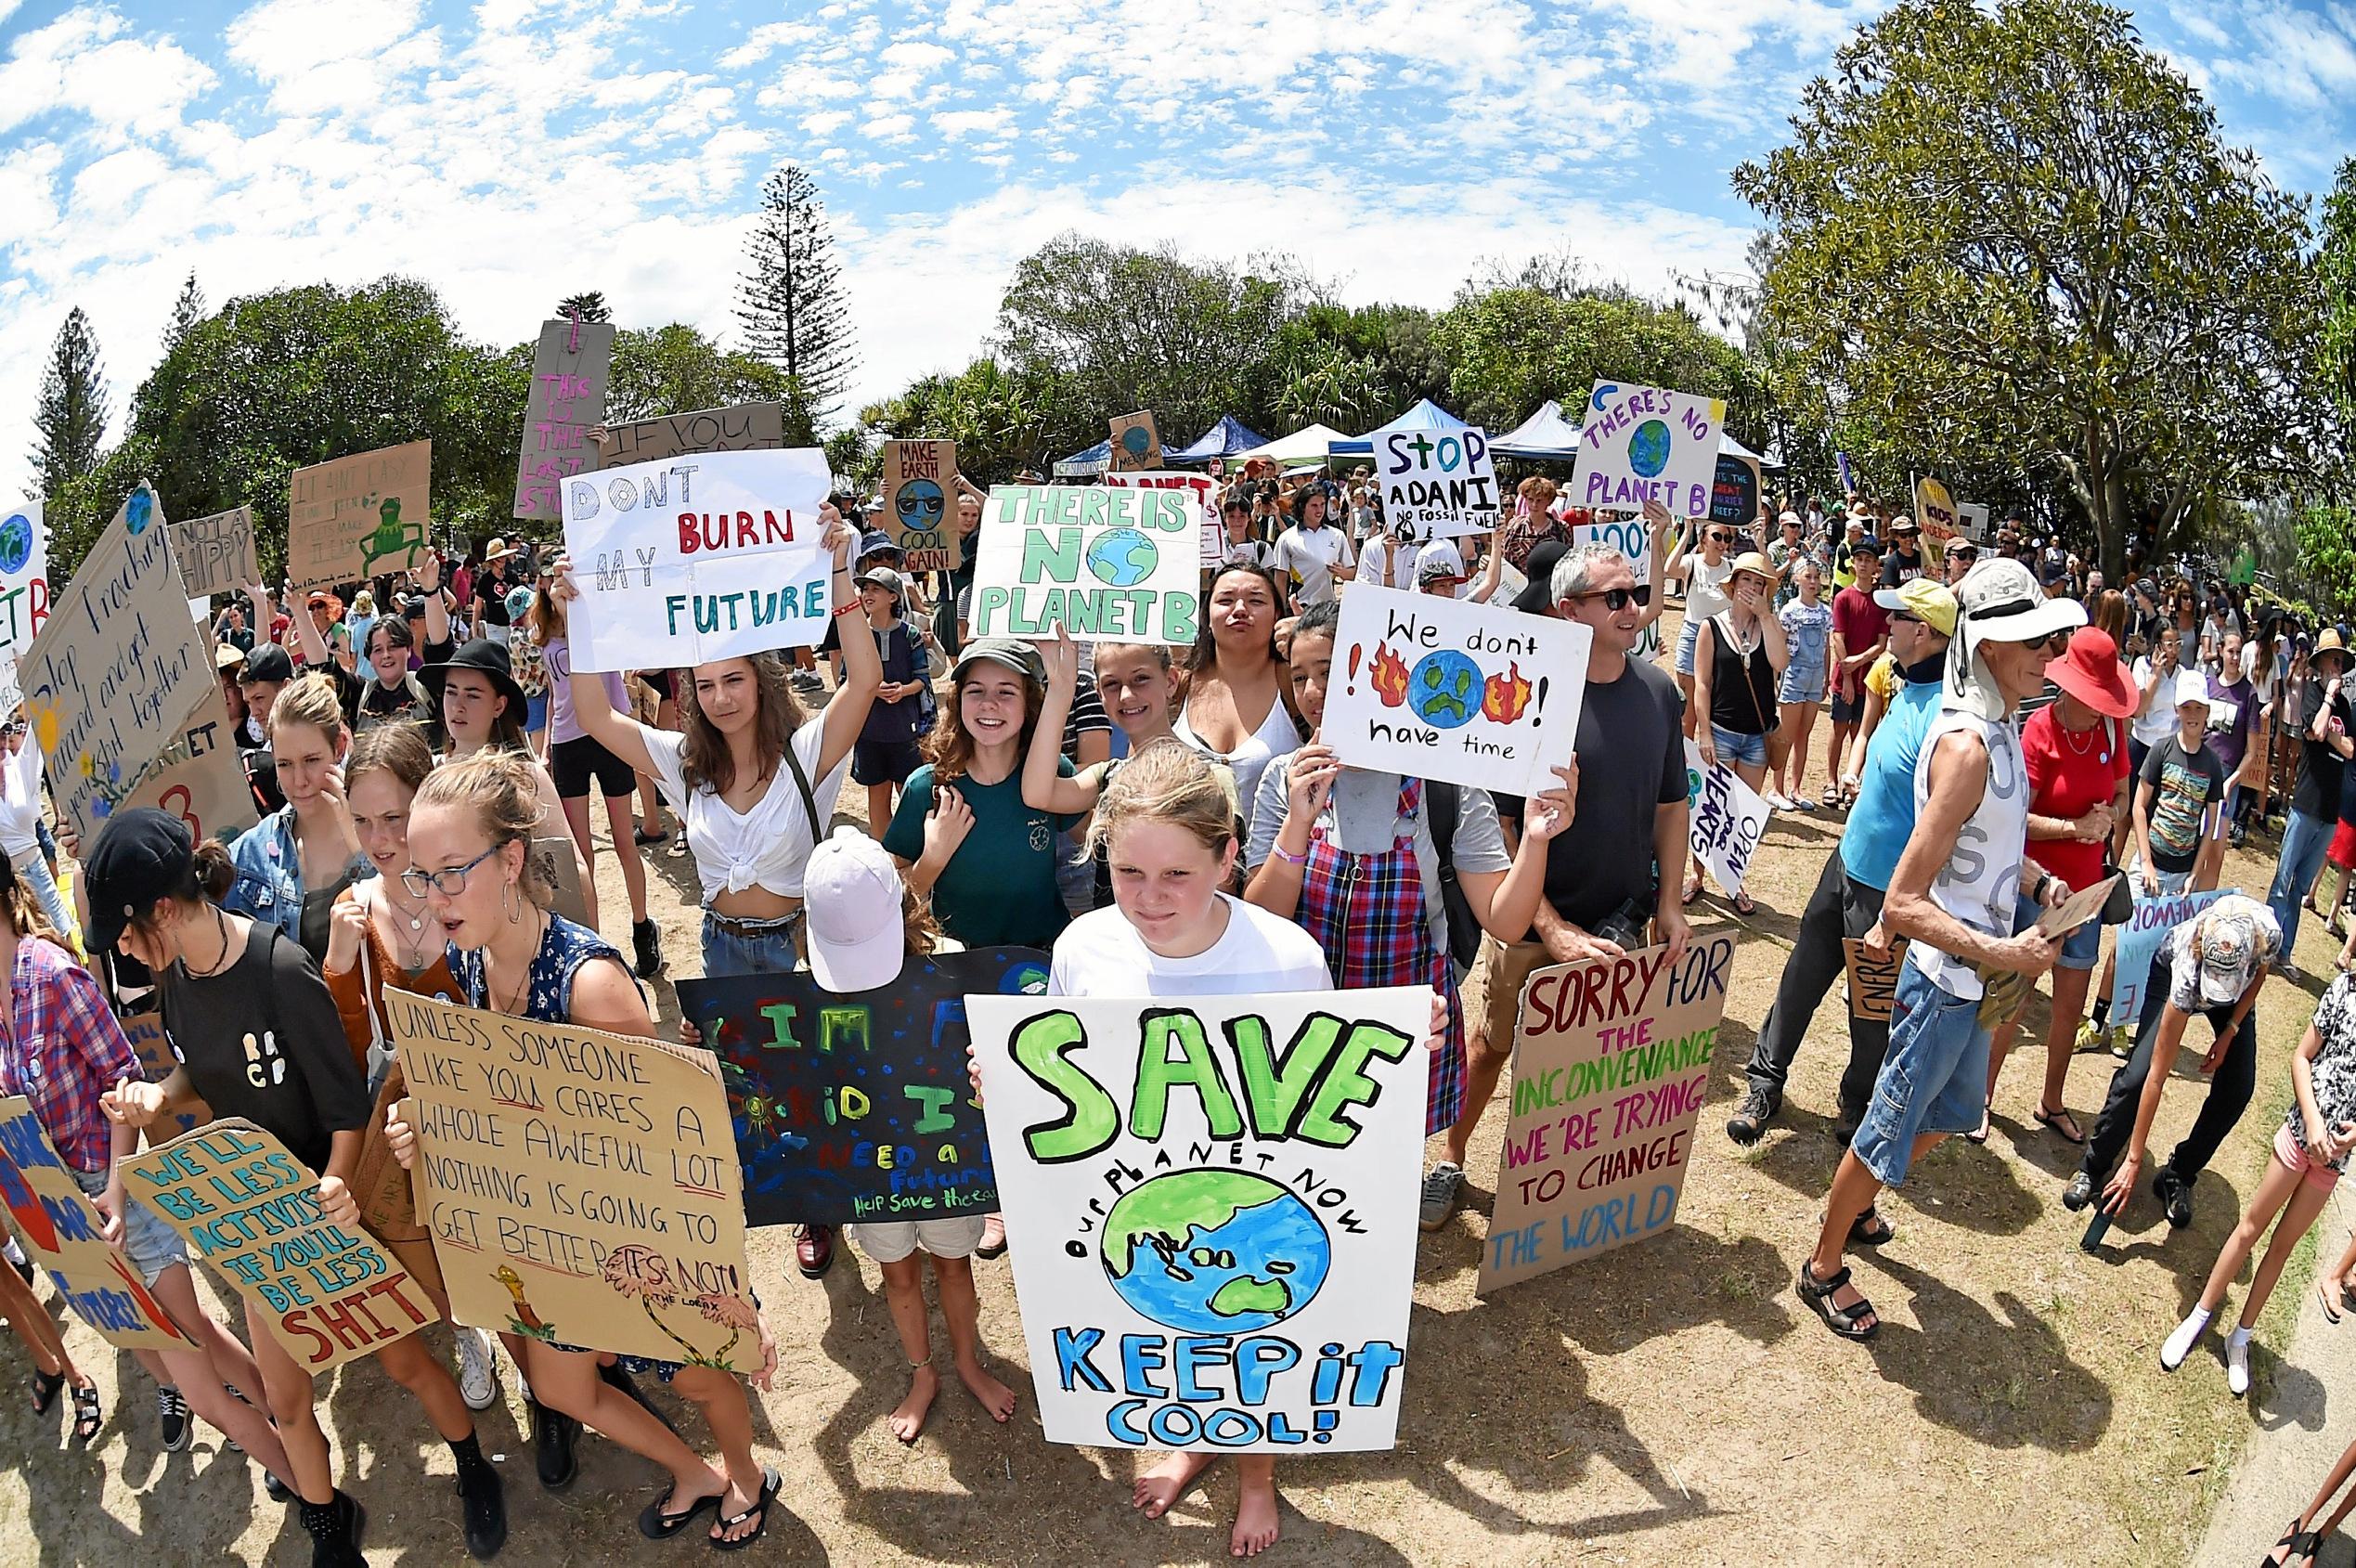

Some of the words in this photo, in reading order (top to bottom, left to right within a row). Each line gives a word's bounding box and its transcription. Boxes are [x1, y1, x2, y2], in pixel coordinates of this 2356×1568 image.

[535, 422, 587, 451] THE
[607, 421, 657, 457] IF
[669, 416, 752, 447] YOU
[1584, 389, 1672, 449] THERE'S
[1681, 407, 1708, 441] NO
[900, 441, 939, 461] MAKE
[900, 461, 939, 479] EARTH
[1730, 473, 1748, 484] THE
[571, 465, 698, 520] DON'T
[990, 487, 1134, 527] THERE
[1141, 491, 1187, 533] IS
[1390, 477, 1497, 511] ADANI
[1396, 510, 1413, 522] NO
[1586, 472, 1678, 509] PLANET
[1689, 484, 1706, 515] B
[1713, 505, 1741, 520] REEF?
[1714, 495, 1743, 506] ARRIER
[1924, 484, 1946, 501] THE
[1926, 503, 1954, 526] KIDS
[179, 515, 225, 546] NOT
[230, 510, 249, 530] A
[678, 510, 795, 554] BURN
[900, 531, 947, 550] COOL
[177, 530, 249, 593] HIPPY
[596, 547, 655, 591] MY
[32, 644, 80, 706] Stop
[82, 524, 170, 635] fracking
[666, 579, 825, 635] FUTURE
[977, 587, 1159, 635] PLANET
[1163, 591, 1198, 643] B
[1387, 609, 1439, 647] We
[1467, 627, 1538, 655] don't
[52, 684, 96, 784] around
[98, 641, 129, 709] and
[128, 612, 152, 696] get
[96, 718, 124, 774] shit
[129, 642, 190, 732] together
[1369, 719, 1439, 746] have
[1463, 733, 1516, 759] time
[1691, 761, 1733, 857] HEARTS
[1727, 816, 1758, 878] OPEN
[1524, 952, 1664, 1036] SORRY
[1666, 938, 1732, 1008] FOR
[391, 1000, 493, 1052] UNLESS
[501, 1025, 652, 1085] SOMEONE
[1597, 1017, 1654, 1055] THE
[405, 1048, 469, 1092] LIKE
[479, 1062, 544, 1108] YOU
[556, 1085, 654, 1133] CARES
[677, 1106, 706, 1147] A
[1007, 1007, 1415, 1165] SAVE
[1514, 1025, 1720, 1117] INCONVENIANCE
[903, 1083, 956, 1135] I
[1507, 1108, 1602, 1170] WE'RE
[1612, 1074, 1707, 1139] TRYING
[134, 1129, 265, 1186] WE'LL
[419, 1098, 506, 1148] WHOLE
[524, 1119, 653, 1176] AWEFUL
[670, 1148, 725, 1191] LOT
[818, 1140, 918, 1170] NEED
[1519, 1169, 1566, 1206] TO
[1576, 1129, 1688, 1190] CHANGE
[152, 1183, 215, 1221] BE
[210, 1152, 302, 1203] LESS
[423, 1152, 532, 1208] NOTHING
[549, 1181, 576, 1214] IS
[580, 1190, 669, 1233] GOING
[676, 1211, 718, 1245] TO
[888, 1193, 936, 1212] Save
[941, 1186, 972, 1209] the
[1104, 1141, 1275, 1196] PLANET
[1292, 1168, 1368, 1235] NOW
[189, 1183, 327, 1256] ACTIVIS
[1489, 1220, 1546, 1272] THE
[1561, 1184, 1676, 1254] WORLD
[221, 1249, 265, 1285] IF
[261, 1225, 360, 1271] YOU'LL
[432, 1201, 482, 1250] GET
[497, 1215, 607, 1277] BETTER
[676, 1257, 741, 1299] NOT!
[256, 1277, 315, 1313] BE
[311, 1247, 389, 1295] LESS
[653, 1292, 676, 1304] THE
[681, 1297, 720, 1312] LORAX
[281, 1272, 428, 1364] SHIT
[1051, 1326, 1303, 1406] KEEP
[1310, 1341, 1405, 1406] it
[1106, 1399, 1340, 1446] COOL!
